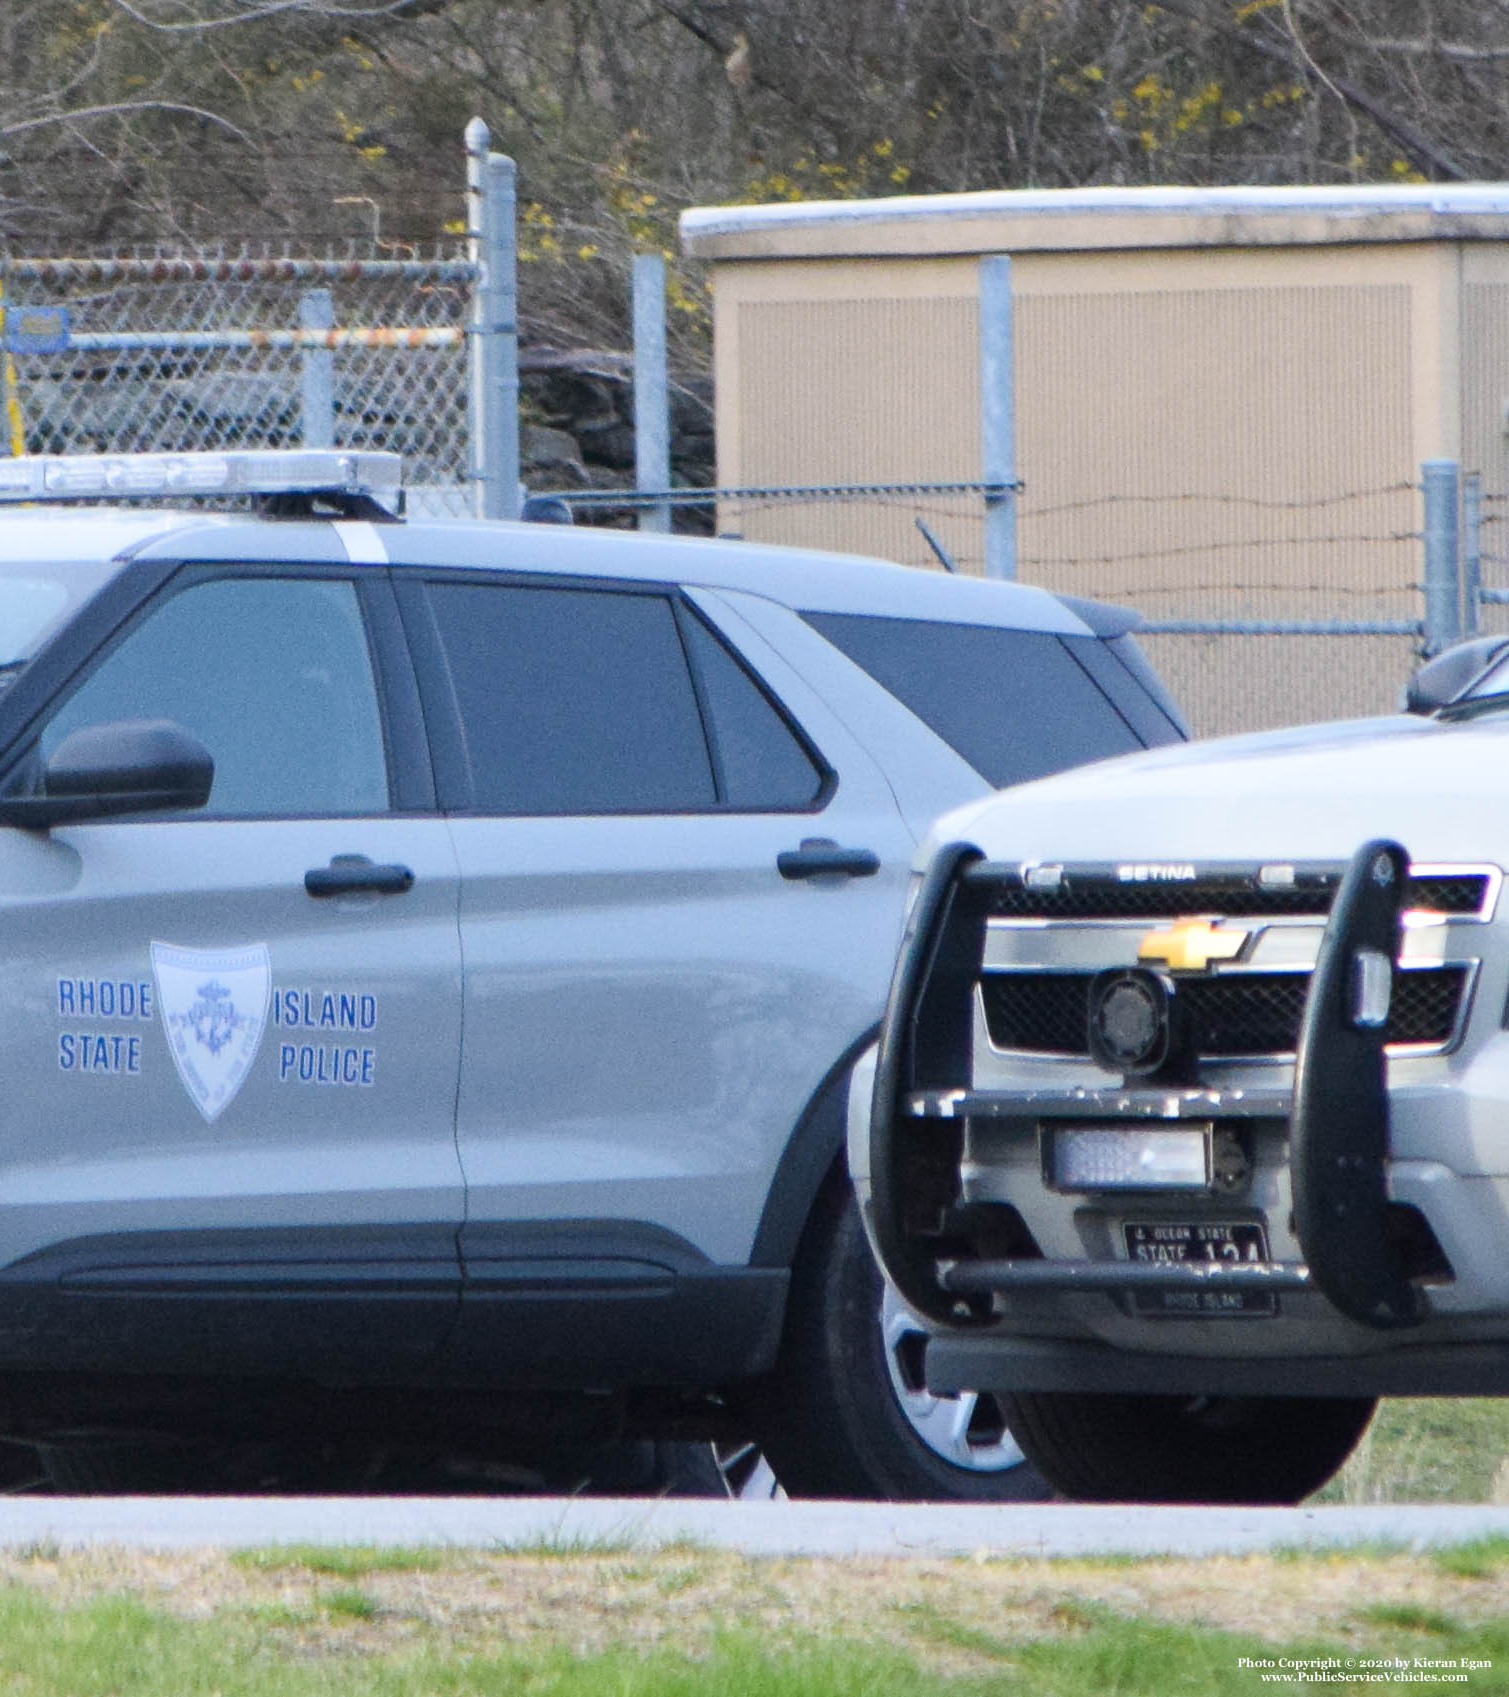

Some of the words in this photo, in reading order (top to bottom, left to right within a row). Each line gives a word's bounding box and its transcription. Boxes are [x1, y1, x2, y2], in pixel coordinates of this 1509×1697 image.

[1117, 863, 1196, 881] SETINA
[58, 979, 152, 1018] RHODE
[273, 990, 377, 1030] ISLAND
[59, 1033, 141, 1072] STATE
[280, 1044, 374, 1084] POLICE
[1154, 1227, 1191, 1240] OCEAN
[1197, 1227, 1233, 1240] STATE
